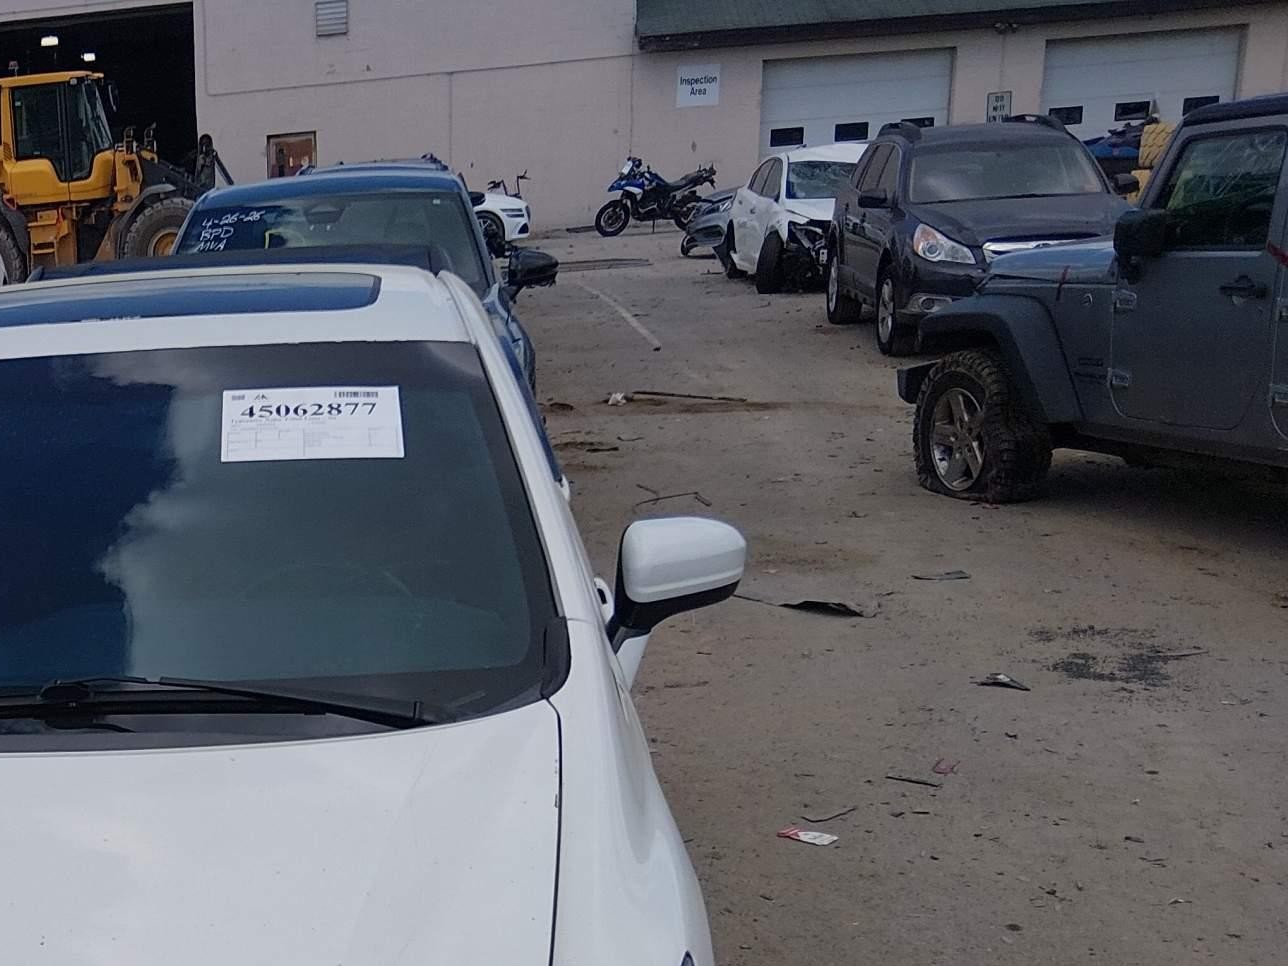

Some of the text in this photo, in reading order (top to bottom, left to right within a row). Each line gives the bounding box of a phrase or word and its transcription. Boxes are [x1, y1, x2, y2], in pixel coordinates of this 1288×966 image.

[680, 75, 718, 86] Inspection
[689, 87, 707, 96] Area
[200, 226, 234, 241] BPD
[196, 239, 227, 252] MVA
[240, 402, 377, 419] 45062877
